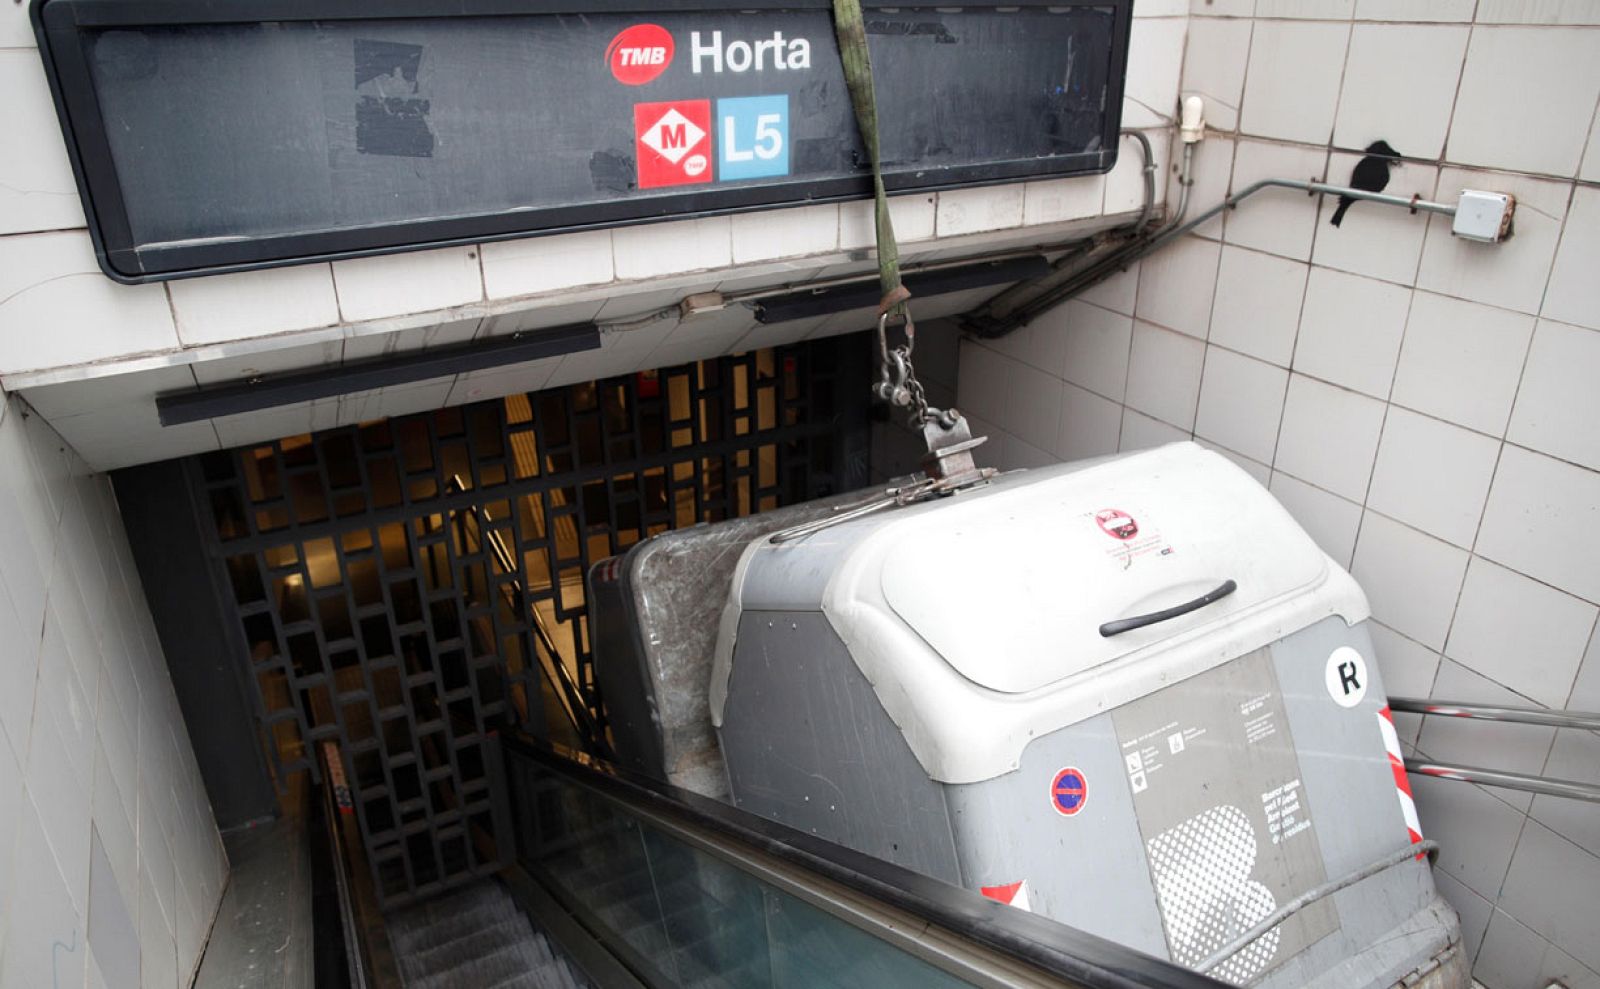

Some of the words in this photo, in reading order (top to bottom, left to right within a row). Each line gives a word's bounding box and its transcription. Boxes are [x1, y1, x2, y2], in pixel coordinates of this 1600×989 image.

[620, 47, 666, 66] TMB
[691, 31, 810, 73] Horta
[660, 123, 686, 149] M
[724, 113, 783, 162] L5
[1337, 661, 1361, 695] R
